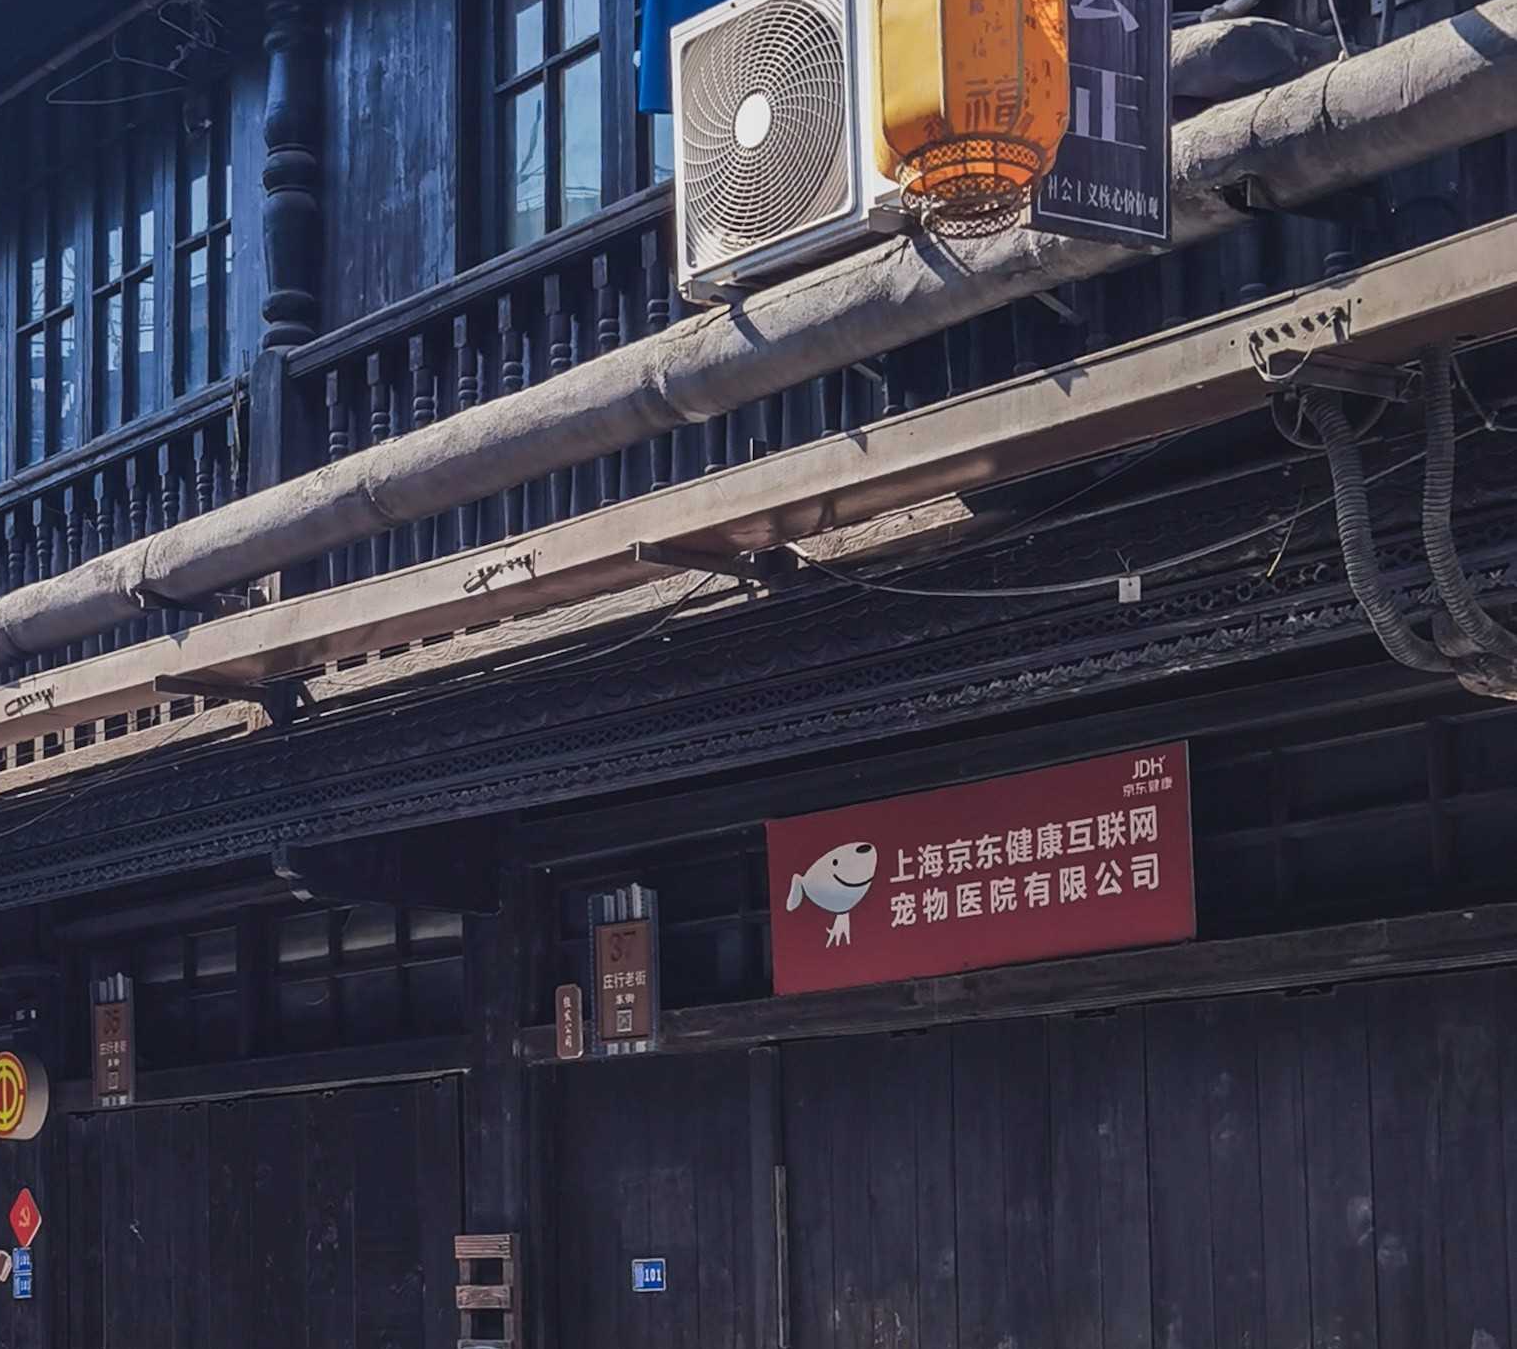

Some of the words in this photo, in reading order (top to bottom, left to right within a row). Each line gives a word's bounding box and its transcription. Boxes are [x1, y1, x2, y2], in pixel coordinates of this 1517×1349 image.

[1122, 775, 1174, 798] 京东健康
[889, 804, 1159, 884] 上海京东健康互联网
[889, 852, 1161, 928] 宠物医院有限公司
[602, 969, 647, 991] 庄行老街
[645, 1267, 663, 1283] 101
